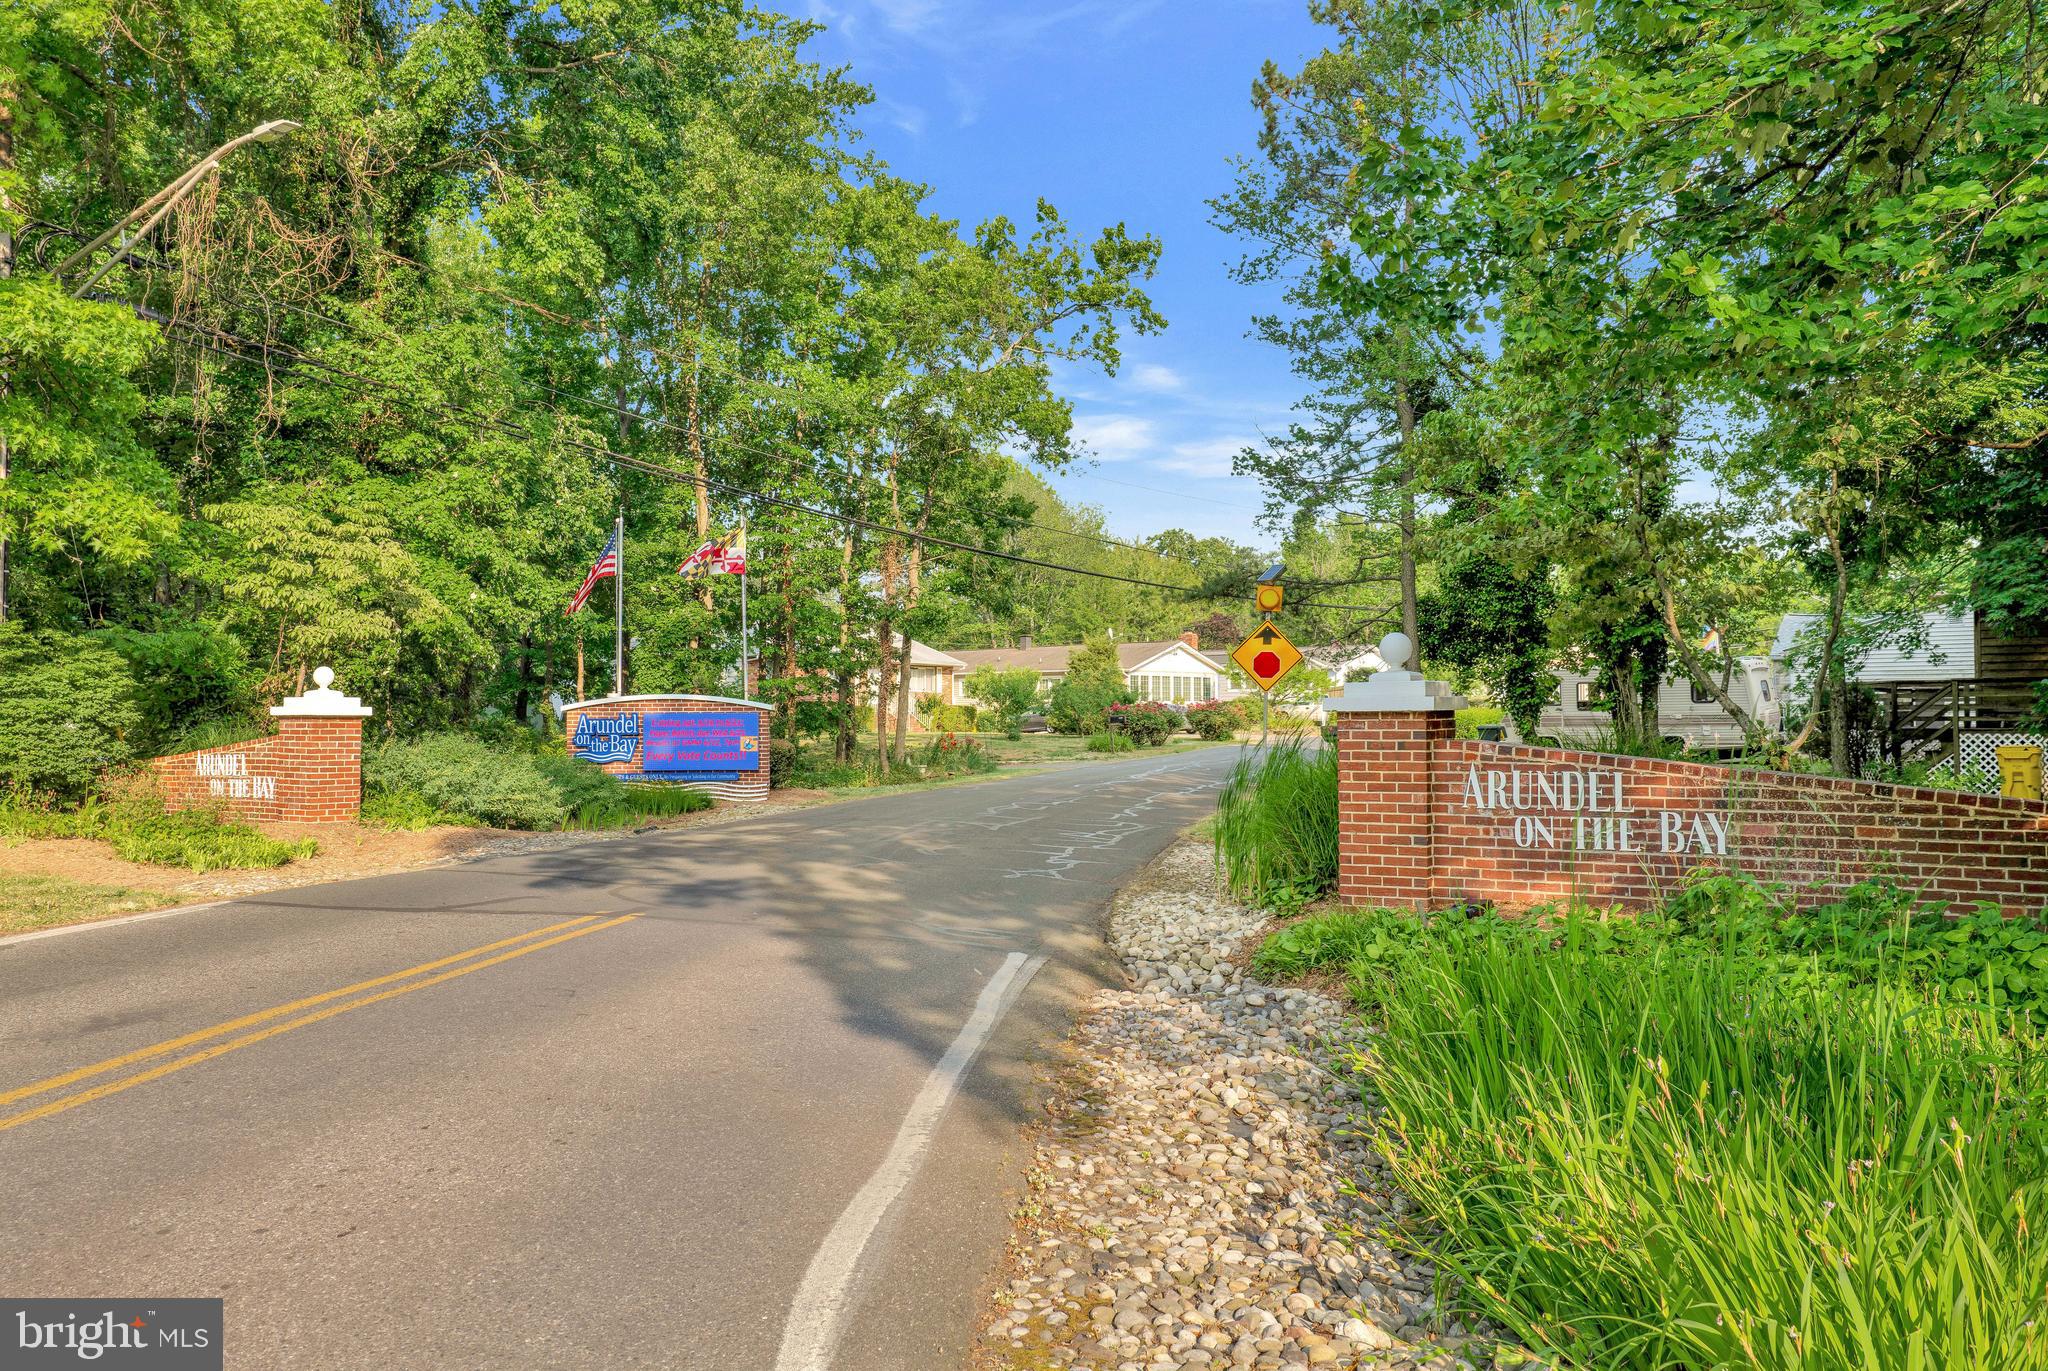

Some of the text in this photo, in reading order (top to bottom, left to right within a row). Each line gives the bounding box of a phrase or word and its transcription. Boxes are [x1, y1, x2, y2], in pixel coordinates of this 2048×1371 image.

[577, 713, 638, 733] Arundel
[195, 750, 248, 776] ARUNDEL
[645, 750, 747, 763] Every Vote Counts!!
[210, 776, 276, 800] ON THE BAY
[1462, 762, 1635, 813] ARUNDEL
[1515, 811, 1733, 855] ON THE BAY
